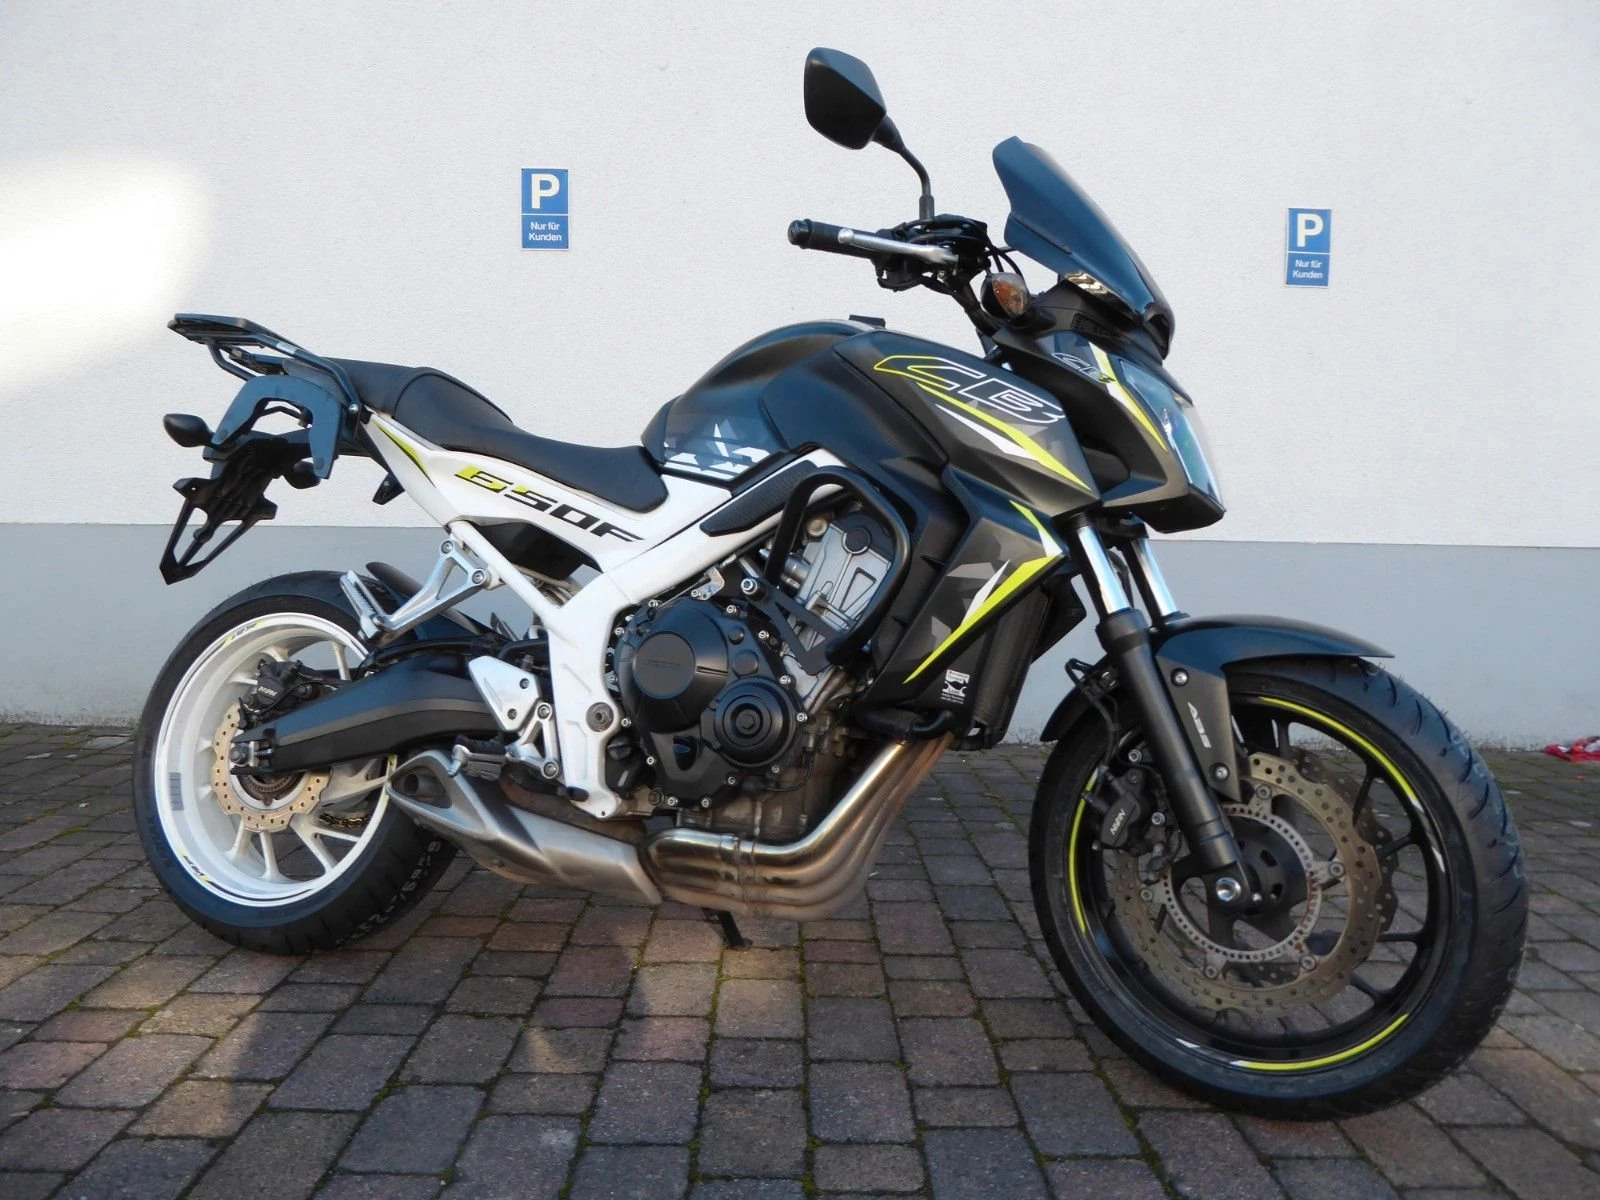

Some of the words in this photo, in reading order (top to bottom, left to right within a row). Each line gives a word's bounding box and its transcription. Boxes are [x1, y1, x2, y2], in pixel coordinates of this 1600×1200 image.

[531, 173, 560, 209] P
[530, 221, 547, 231] Nur
[548, 221, 560, 231] für
[1297, 213, 1324, 247] P
[528, 232, 562, 242] Kunden
[1295, 259, 1309, 268] Nur
[1310, 260, 1322, 269] für
[1292, 270, 1323, 279] Kunden
[454, 464, 646, 543] 650F
